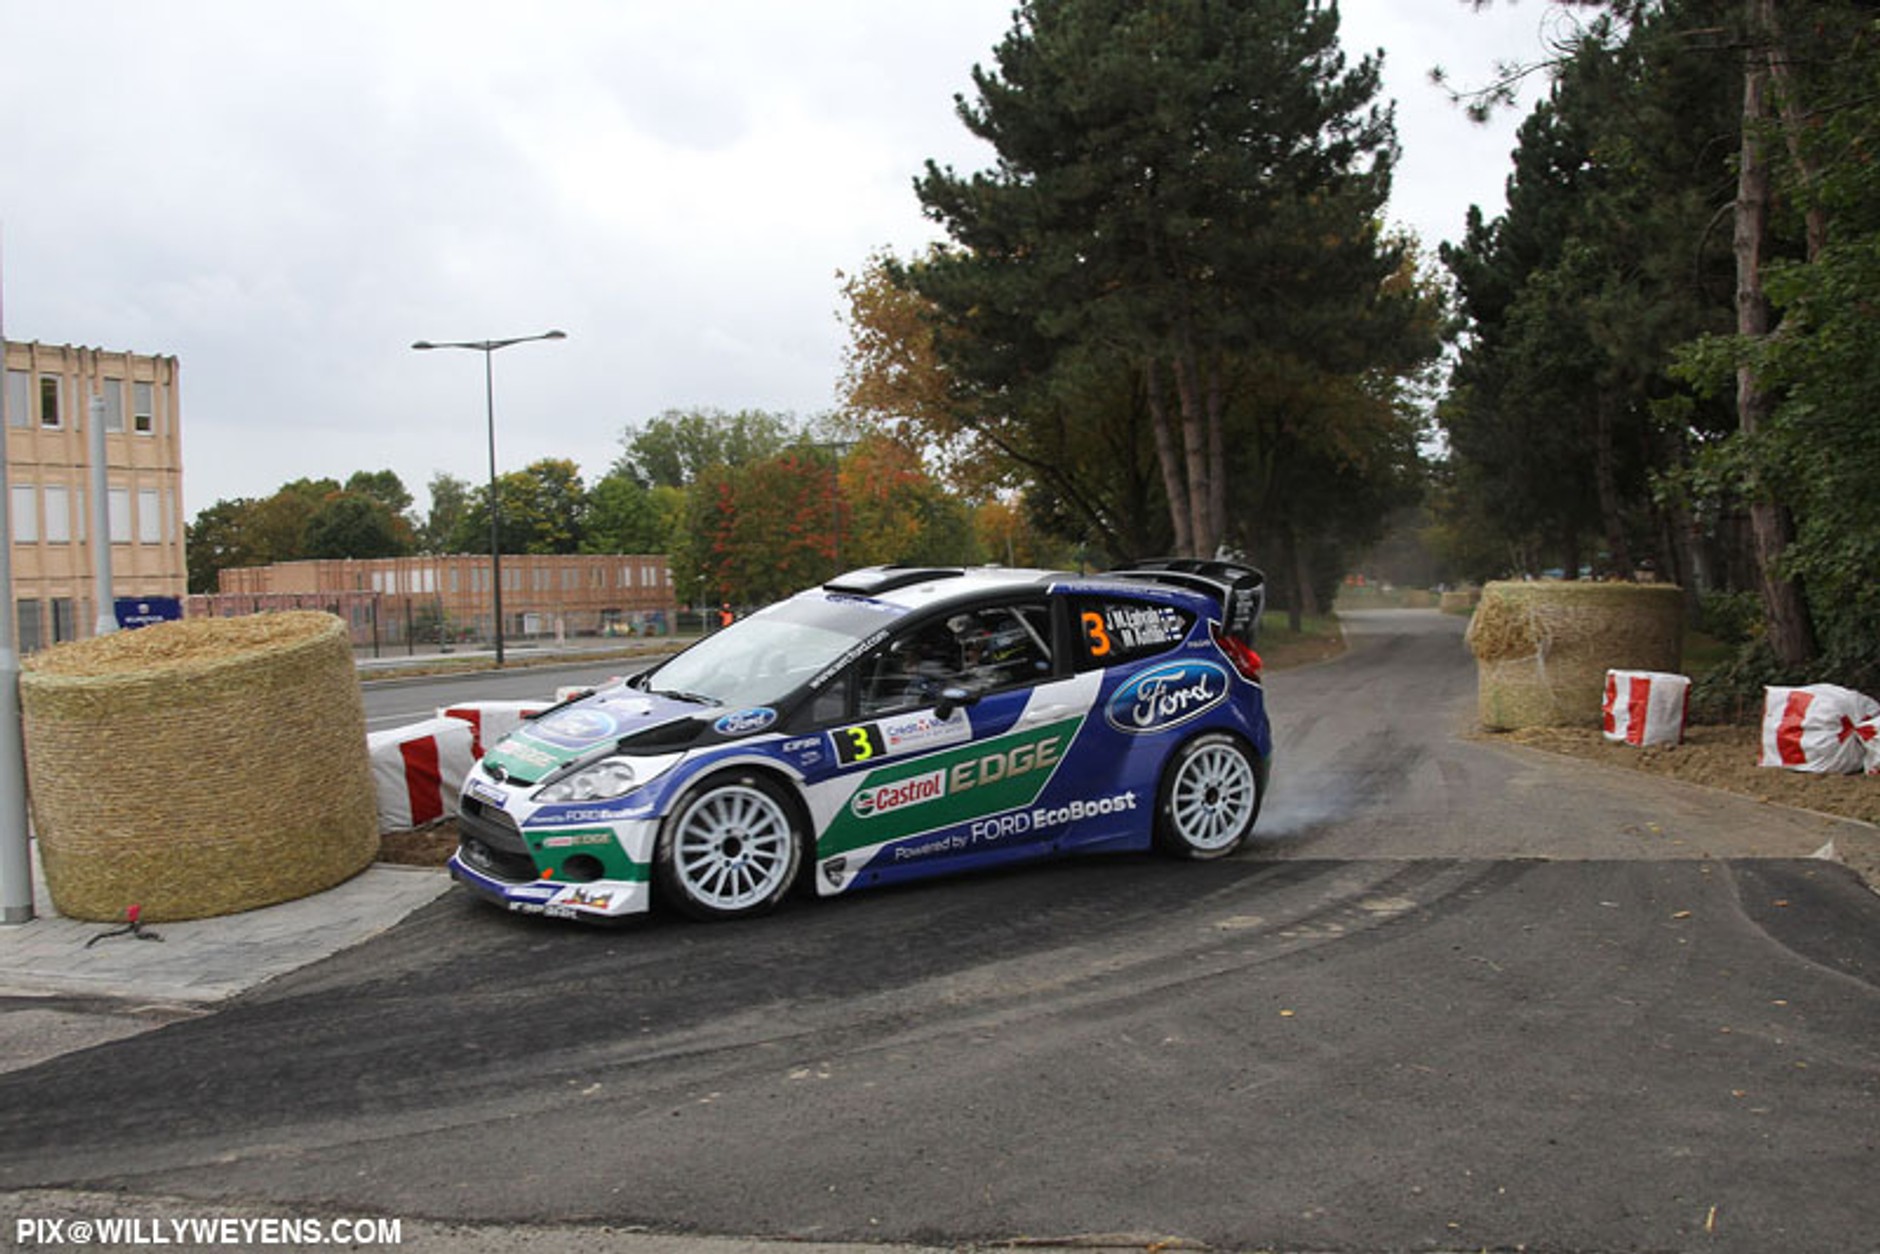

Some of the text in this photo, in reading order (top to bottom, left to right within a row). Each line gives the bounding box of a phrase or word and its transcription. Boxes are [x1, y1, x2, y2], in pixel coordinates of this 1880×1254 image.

[1081, 611, 1110, 656] 3
[1132, 669, 1214, 726] Ford
[846, 727, 873, 761] 3
[875, 735, 1061, 810] Castrol EDGE
[895, 790, 1137, 860] Powered by FORD EcoBoost
